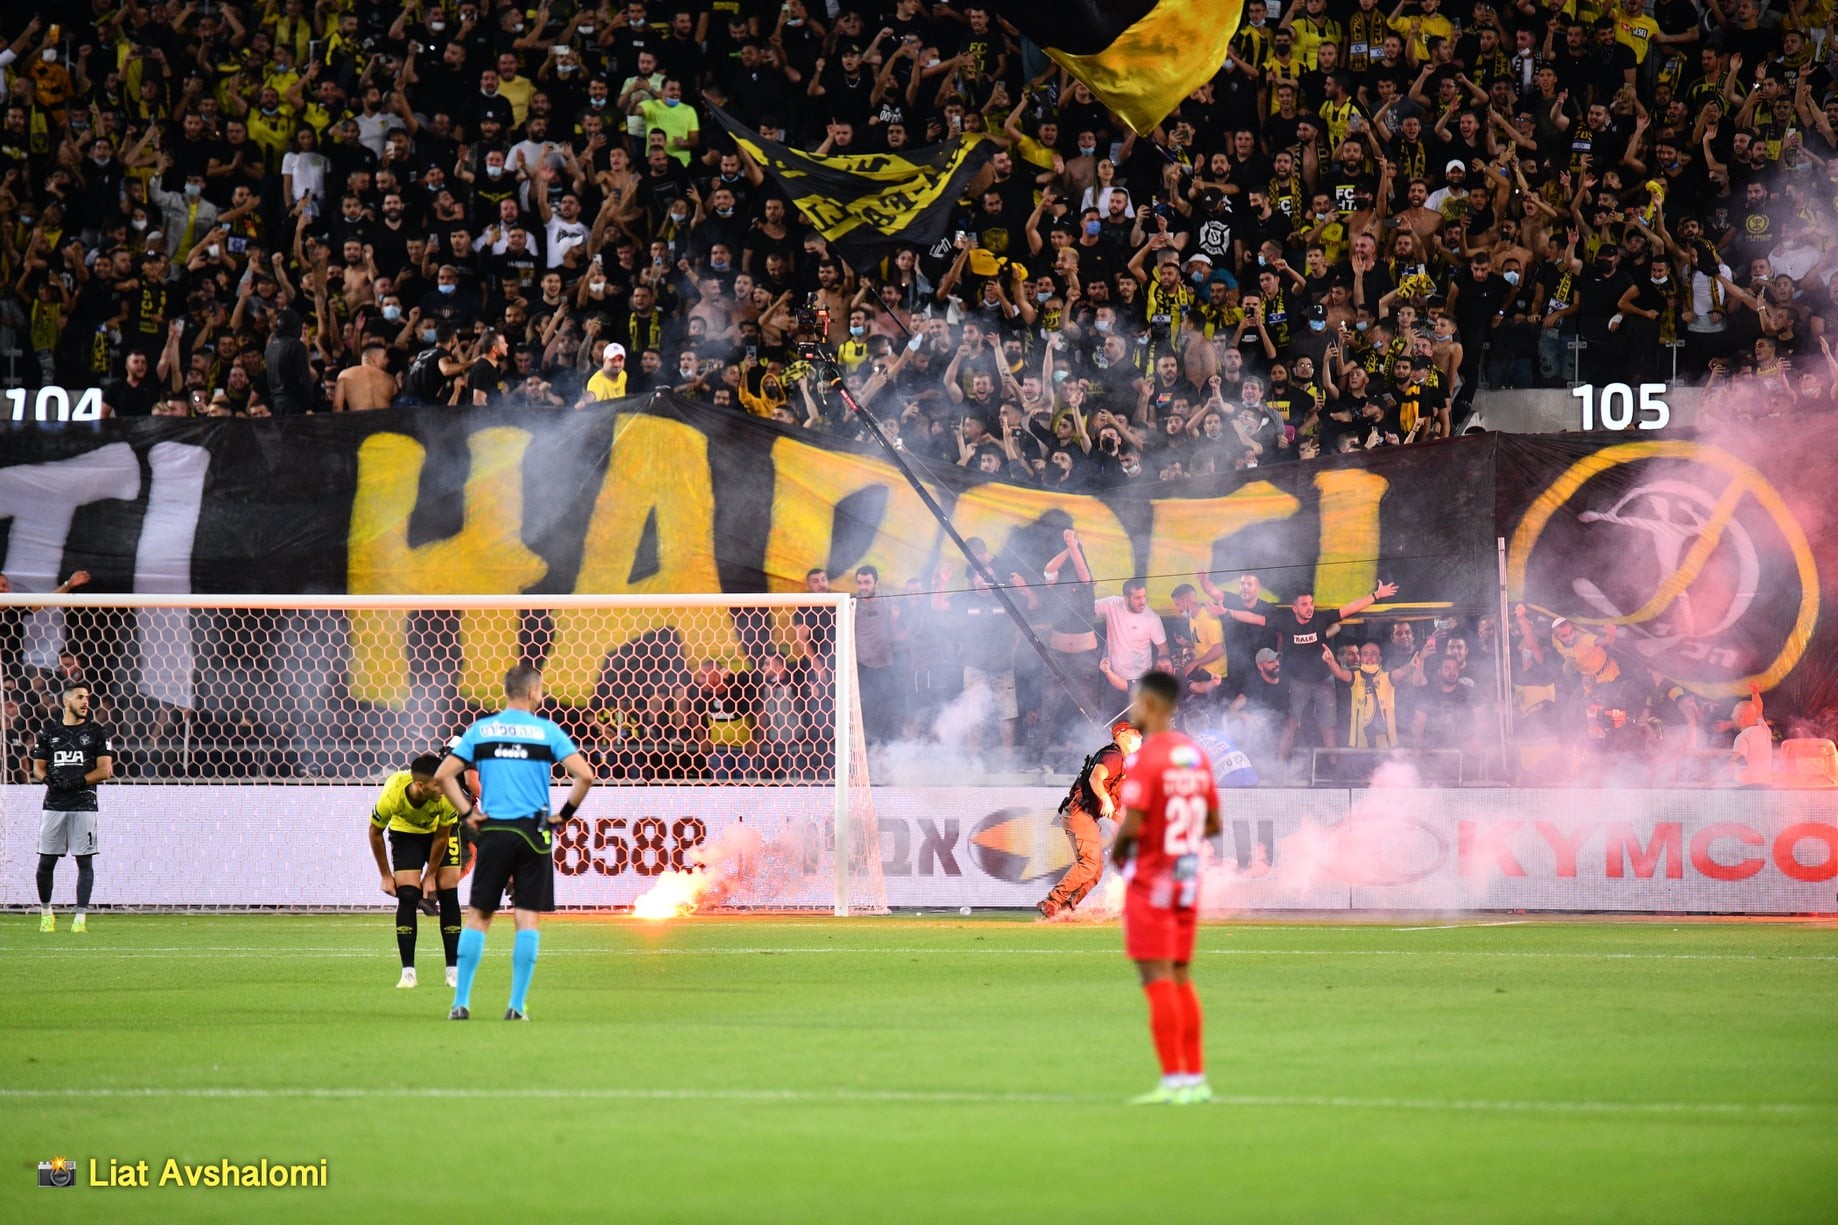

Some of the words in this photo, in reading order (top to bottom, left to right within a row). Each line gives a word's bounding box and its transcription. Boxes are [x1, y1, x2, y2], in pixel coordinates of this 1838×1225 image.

[5, 386, 103, 421] 104
[1573, 383, 1669, 430] 105
[448, 836, 459, 856] 5
[554, 816, 707, 877] 8588
[1456, 820, 1838, 881] KYMCO
